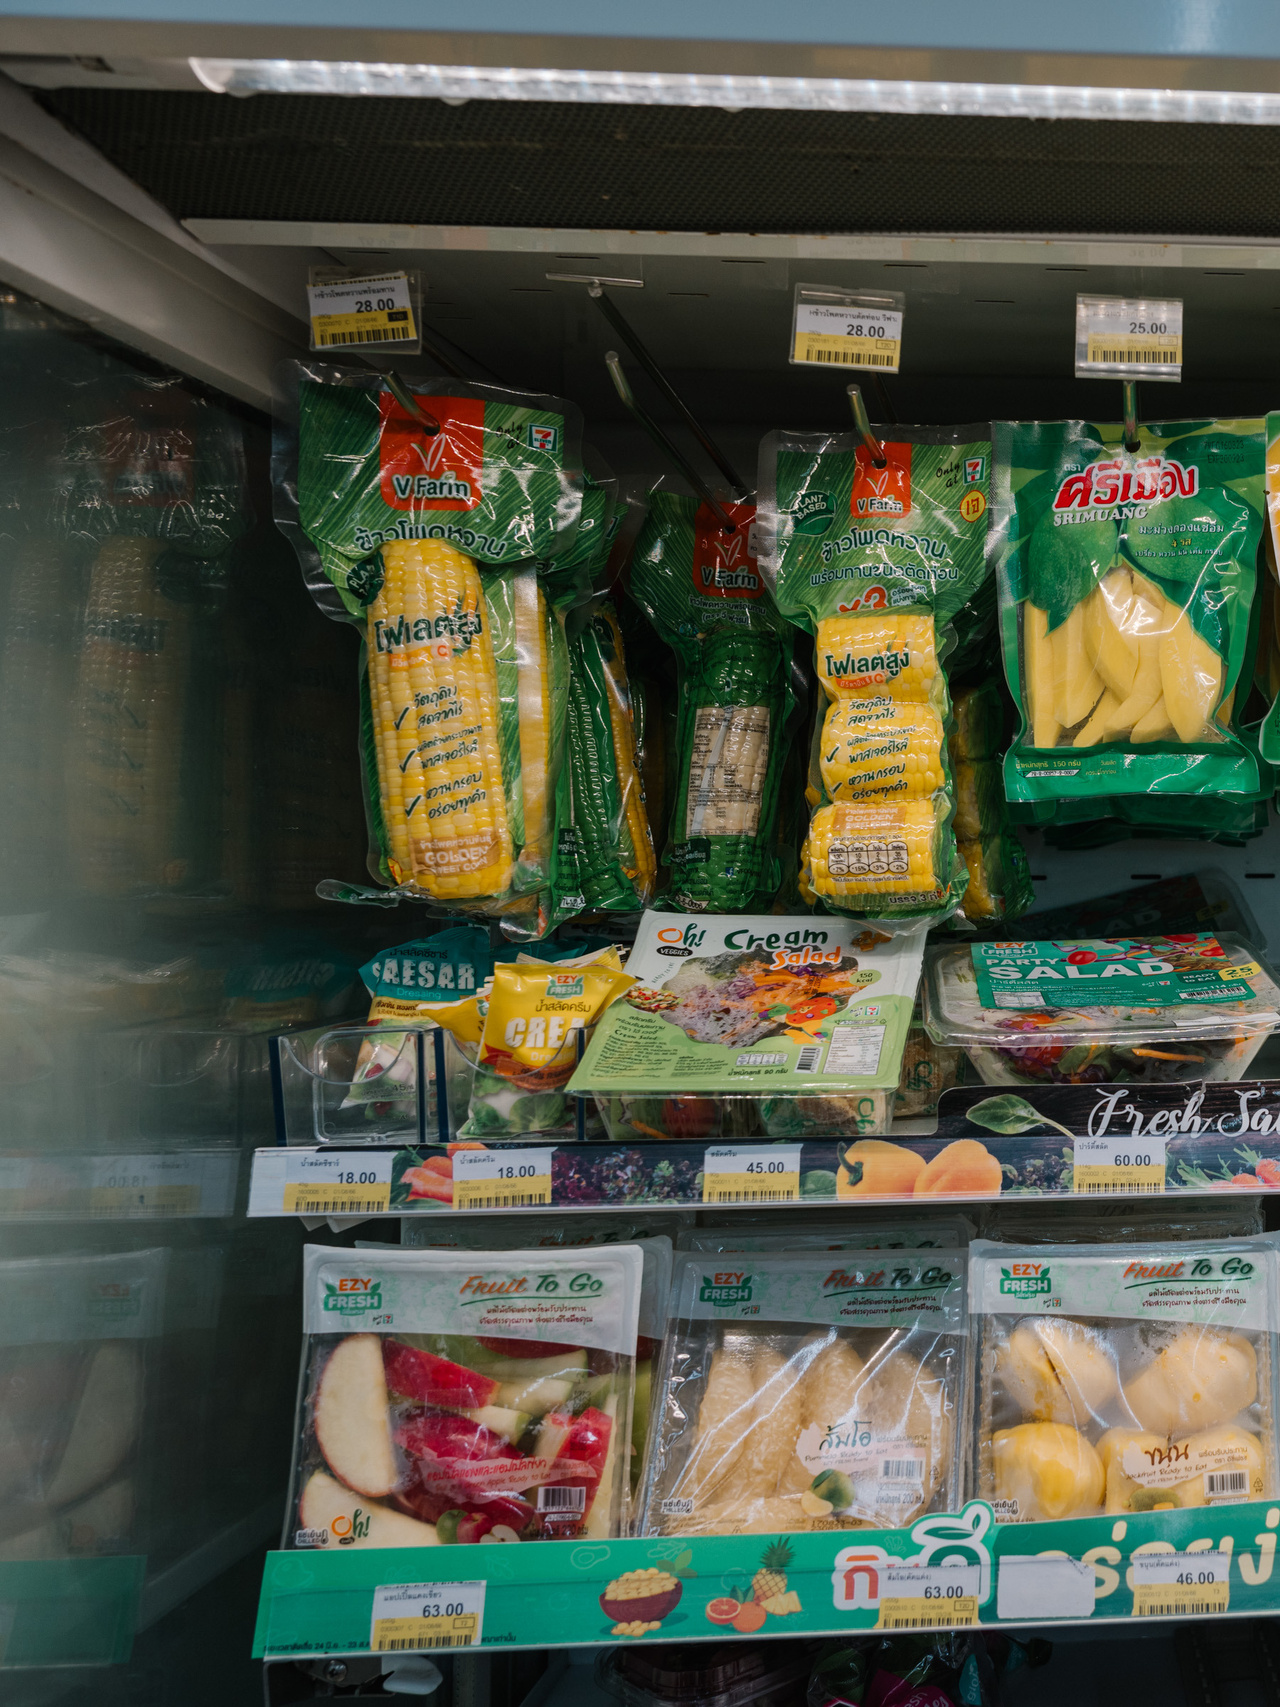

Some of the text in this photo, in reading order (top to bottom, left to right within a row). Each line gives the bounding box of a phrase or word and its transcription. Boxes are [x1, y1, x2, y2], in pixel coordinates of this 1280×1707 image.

[355, 298, 394, 313] 28.00
[846, 324, 885, 338] 28.00
[1129, 322, 1167, 335] 25.00
[394, 476, 471, 499] V Farm
[1054, 456, 1198, 510] ศรีเมือง
[857, 500, 902, 512] V Farm
[966, 498, 980, 516] เจ
[1052, 506, 1149, 528] SRIMUANG
[822, 527, 946, 563] ข้าวโพดหวาน
[702, 567, 758, 590] V Farm
[825, 650, 910, 676] โฟเลตสูง
[848, 696, 893, 712] วัตถุดิบ
[848, 709, 896, 726] สดจากไร่
[848, 762, 906, 787] หวานกรอบ
[852, 780, 908, 801] อร่อยทุกคำ
[845, 814, 894, 822] GOLDEN
[425, 846, 489, 866] GOLDEN
[657, 922, 829, 951] Oh! Cream
[660, 948, 690, 956] VEGGIES
[770, 946, 842, 970] Salad
[986, 957, 1060, 966] PARTY
[988, 962, 1175, 980] SALAD
[1182, 972, 1216, 980] READY
[1224, 966, 1253, 976] 25
[557, 975, 578, 984] EZY
[396, 988, 442, 1000] Dressing
[550, 986, 582, 995] FRESH
[535, 1000, 592, 1013] น้ำสลัดครีม
[1088, 1088, 1212, 1139] Fresh
[1114, 1154, 1151, 1167] 60.00
[498, 1166, 536, 1179] 18.00
[746, 1162, 785, 1174] 45.00
[337, 1172, 377, 1185] 18.00
[1012, 1263, 1042, 1276] EZY
[1122, 1257, 1254, 1278] Fruit To Go
[459, 1272, 603, 1296] Fruit To Go
[714, 1272, 744, 1286] EZY
[824, 1266, 952, 1288] Fruit To Go
[338, 1278, 372, 1291] EZY
[1002, 1280, 1048, 1292] FRESH
[704, 1288, 750, 1300] FRESH
[328, 1296, 378, 1310] FRESH
[819, 1420, 872, 1450] ส้มโอ
[1144, 1443, 1189, 1469] ขนุน
[1158, 1464, 1208, 1477] Ready Eat
[331, 1508, 370, 1538] Oh!
[1176, 1572, 1215, 1585] 46.00
[924, 1586, 964, 1599] 63.00
[422, 1602, 464, 1618] 63.00
